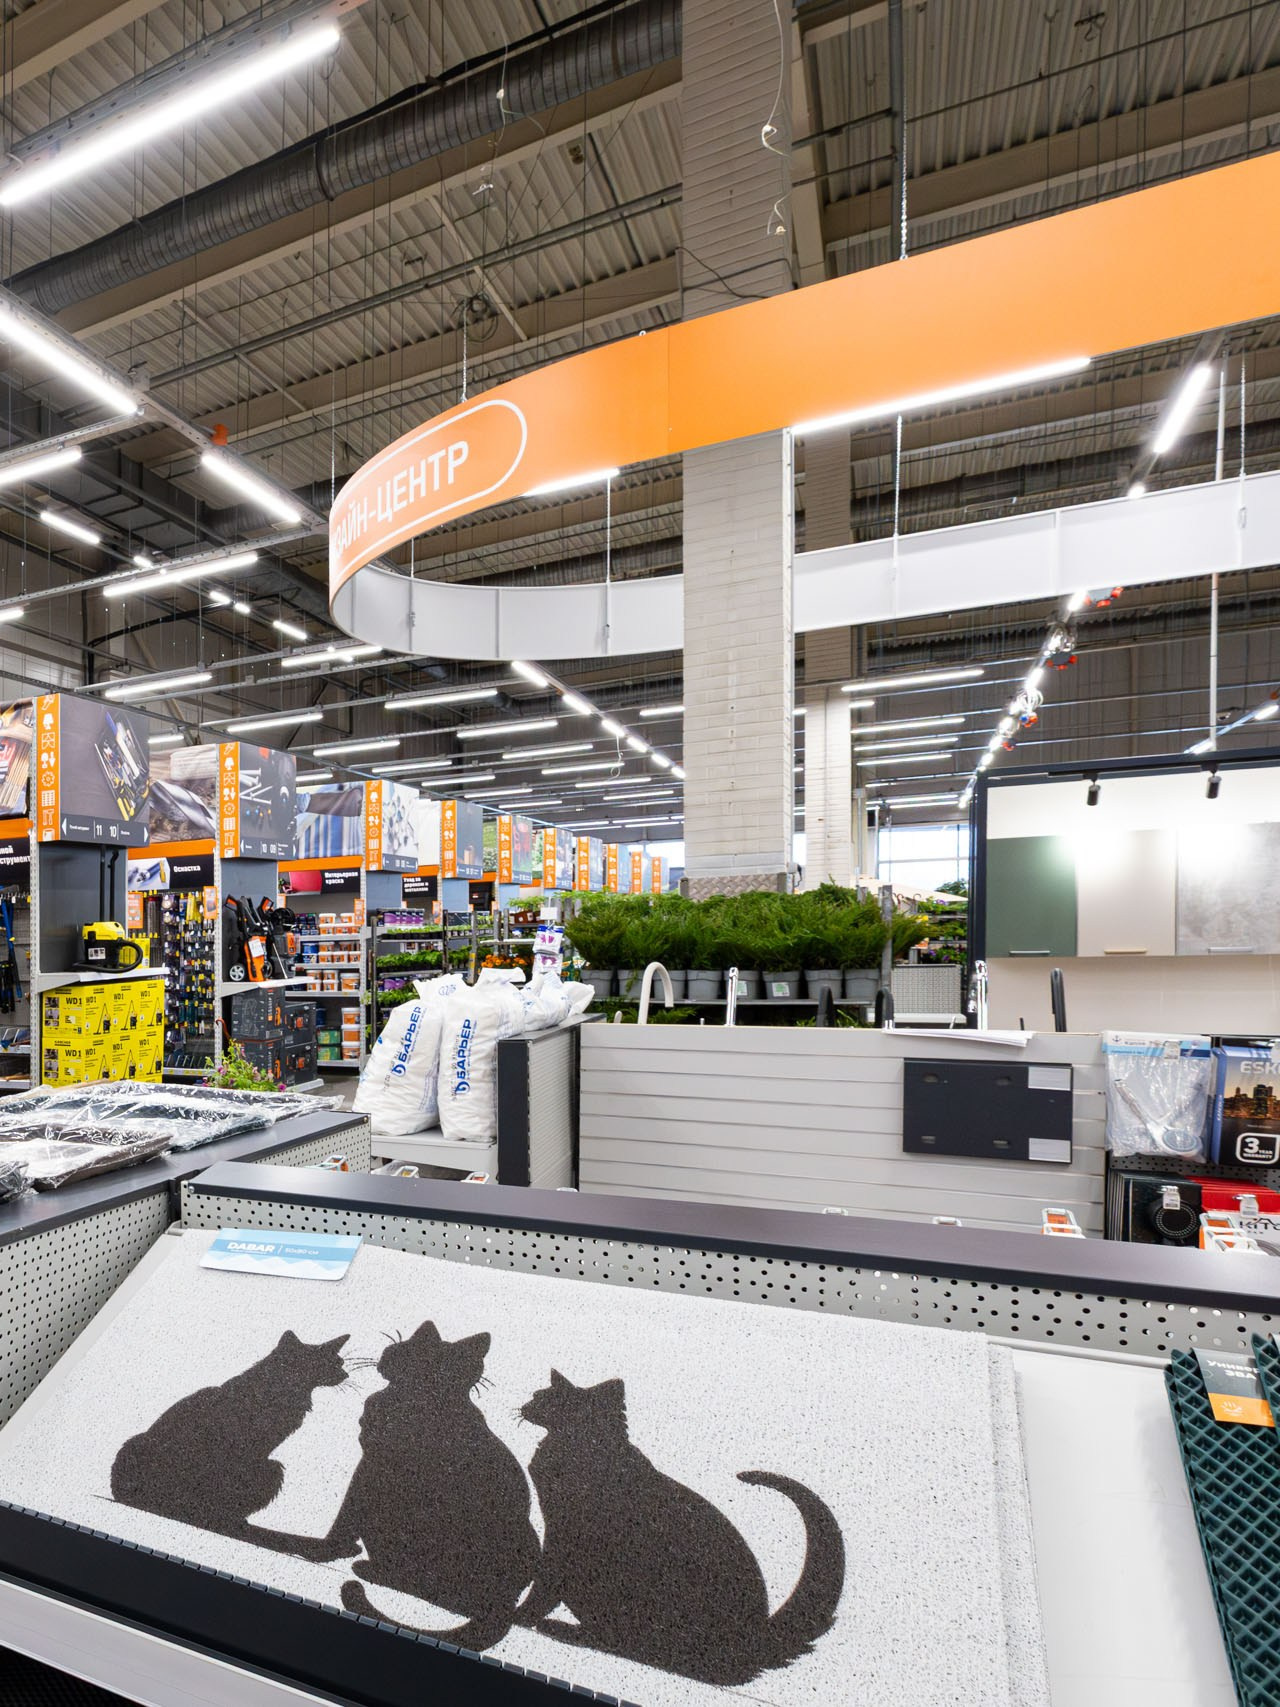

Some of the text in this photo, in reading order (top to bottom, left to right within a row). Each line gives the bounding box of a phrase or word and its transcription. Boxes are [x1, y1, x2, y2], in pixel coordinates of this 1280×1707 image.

[332, 440, 469, 557] ЗАЙН-ЦЕНТР
[96, 825, 102, 836] 11
[110, 825, 117, 838] 10
[173, 865, 201, 873] Оснастка
[324, 871, 358, 879] Интерьерная
[397, 1006, 422, 1063] БАРЬЕР
[455, 1018, 472, 1081] БАРЬЕР
[1243, 1137, 1260, 1154] 3
[227, 1242, 276, 1253] DABAR
[1206, 1359, 1261, 1374] Универ
